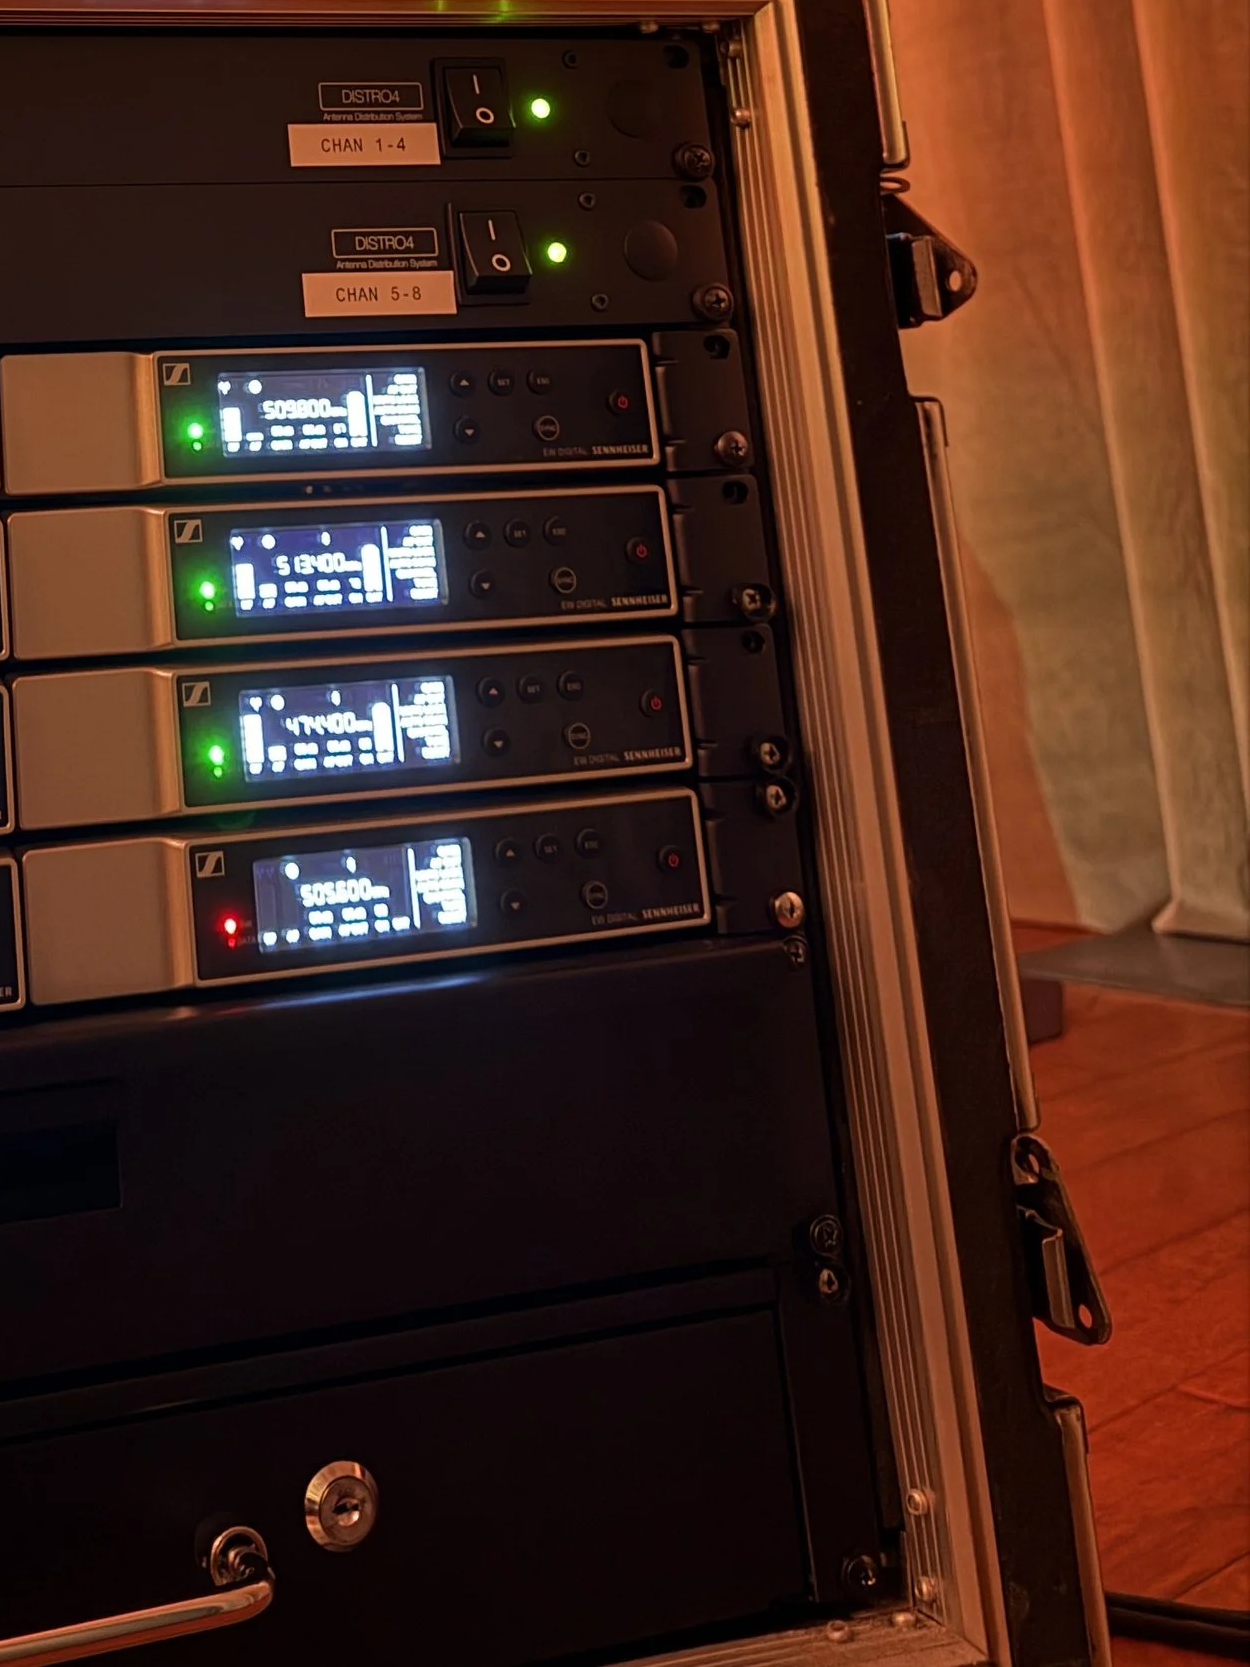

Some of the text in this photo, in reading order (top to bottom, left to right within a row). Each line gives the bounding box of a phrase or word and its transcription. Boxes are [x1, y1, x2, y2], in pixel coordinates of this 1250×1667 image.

[341, 88, 400, 104] DISTRO4
[321, 137, 363, 153] CHAN
[355, 235, 415, 250] DISTRO4
[336, 286, 379, 302] CHAN
